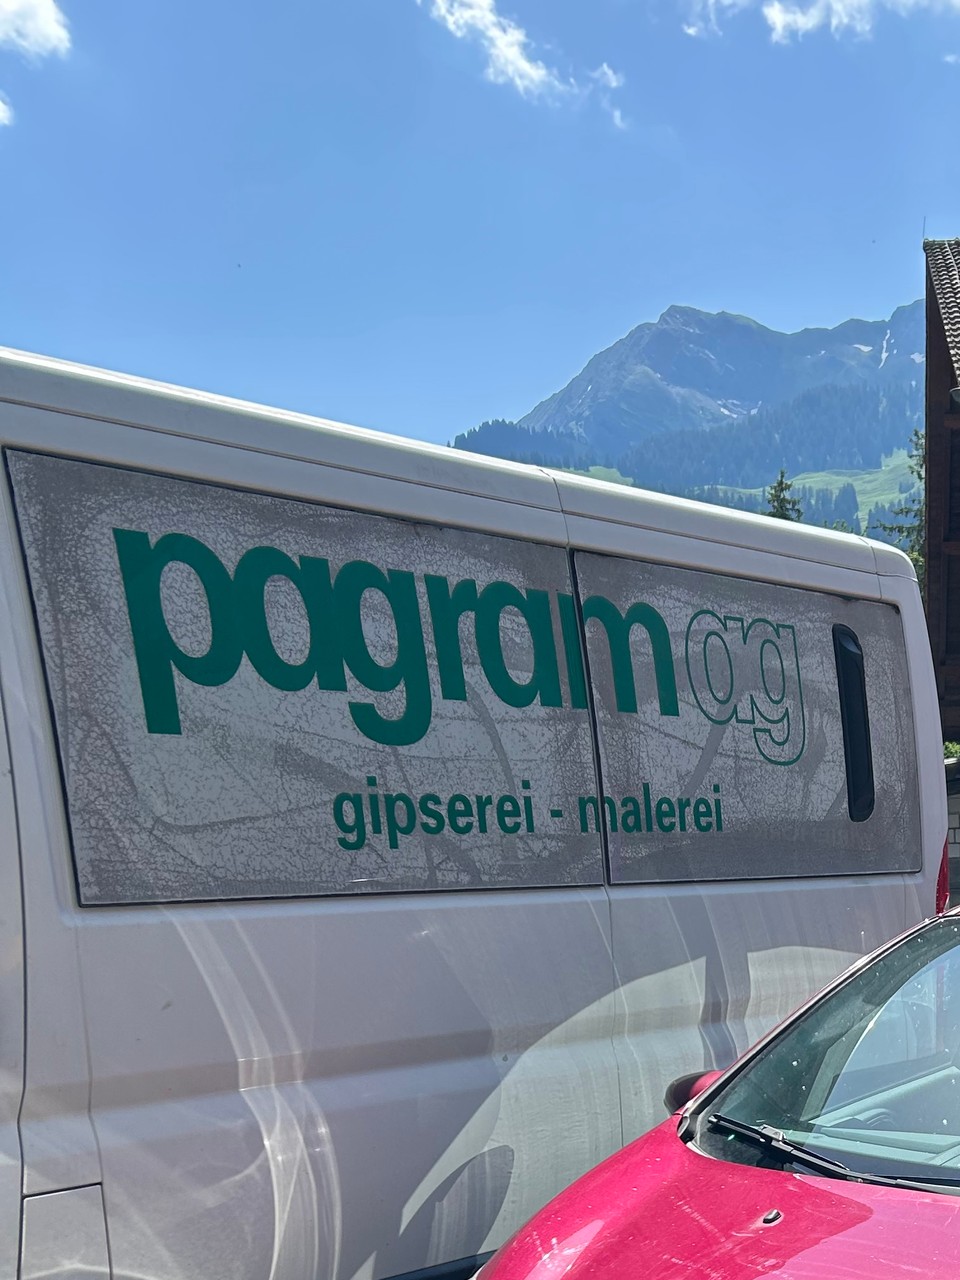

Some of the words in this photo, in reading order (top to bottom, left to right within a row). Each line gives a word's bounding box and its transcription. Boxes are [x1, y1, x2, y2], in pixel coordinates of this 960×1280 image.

[112, 527, 679, 746] pagram
[685, 608, 807, 767] ag
[332, 775, 536, 851] gipserei
[578, 784, 724, 836] malerei
